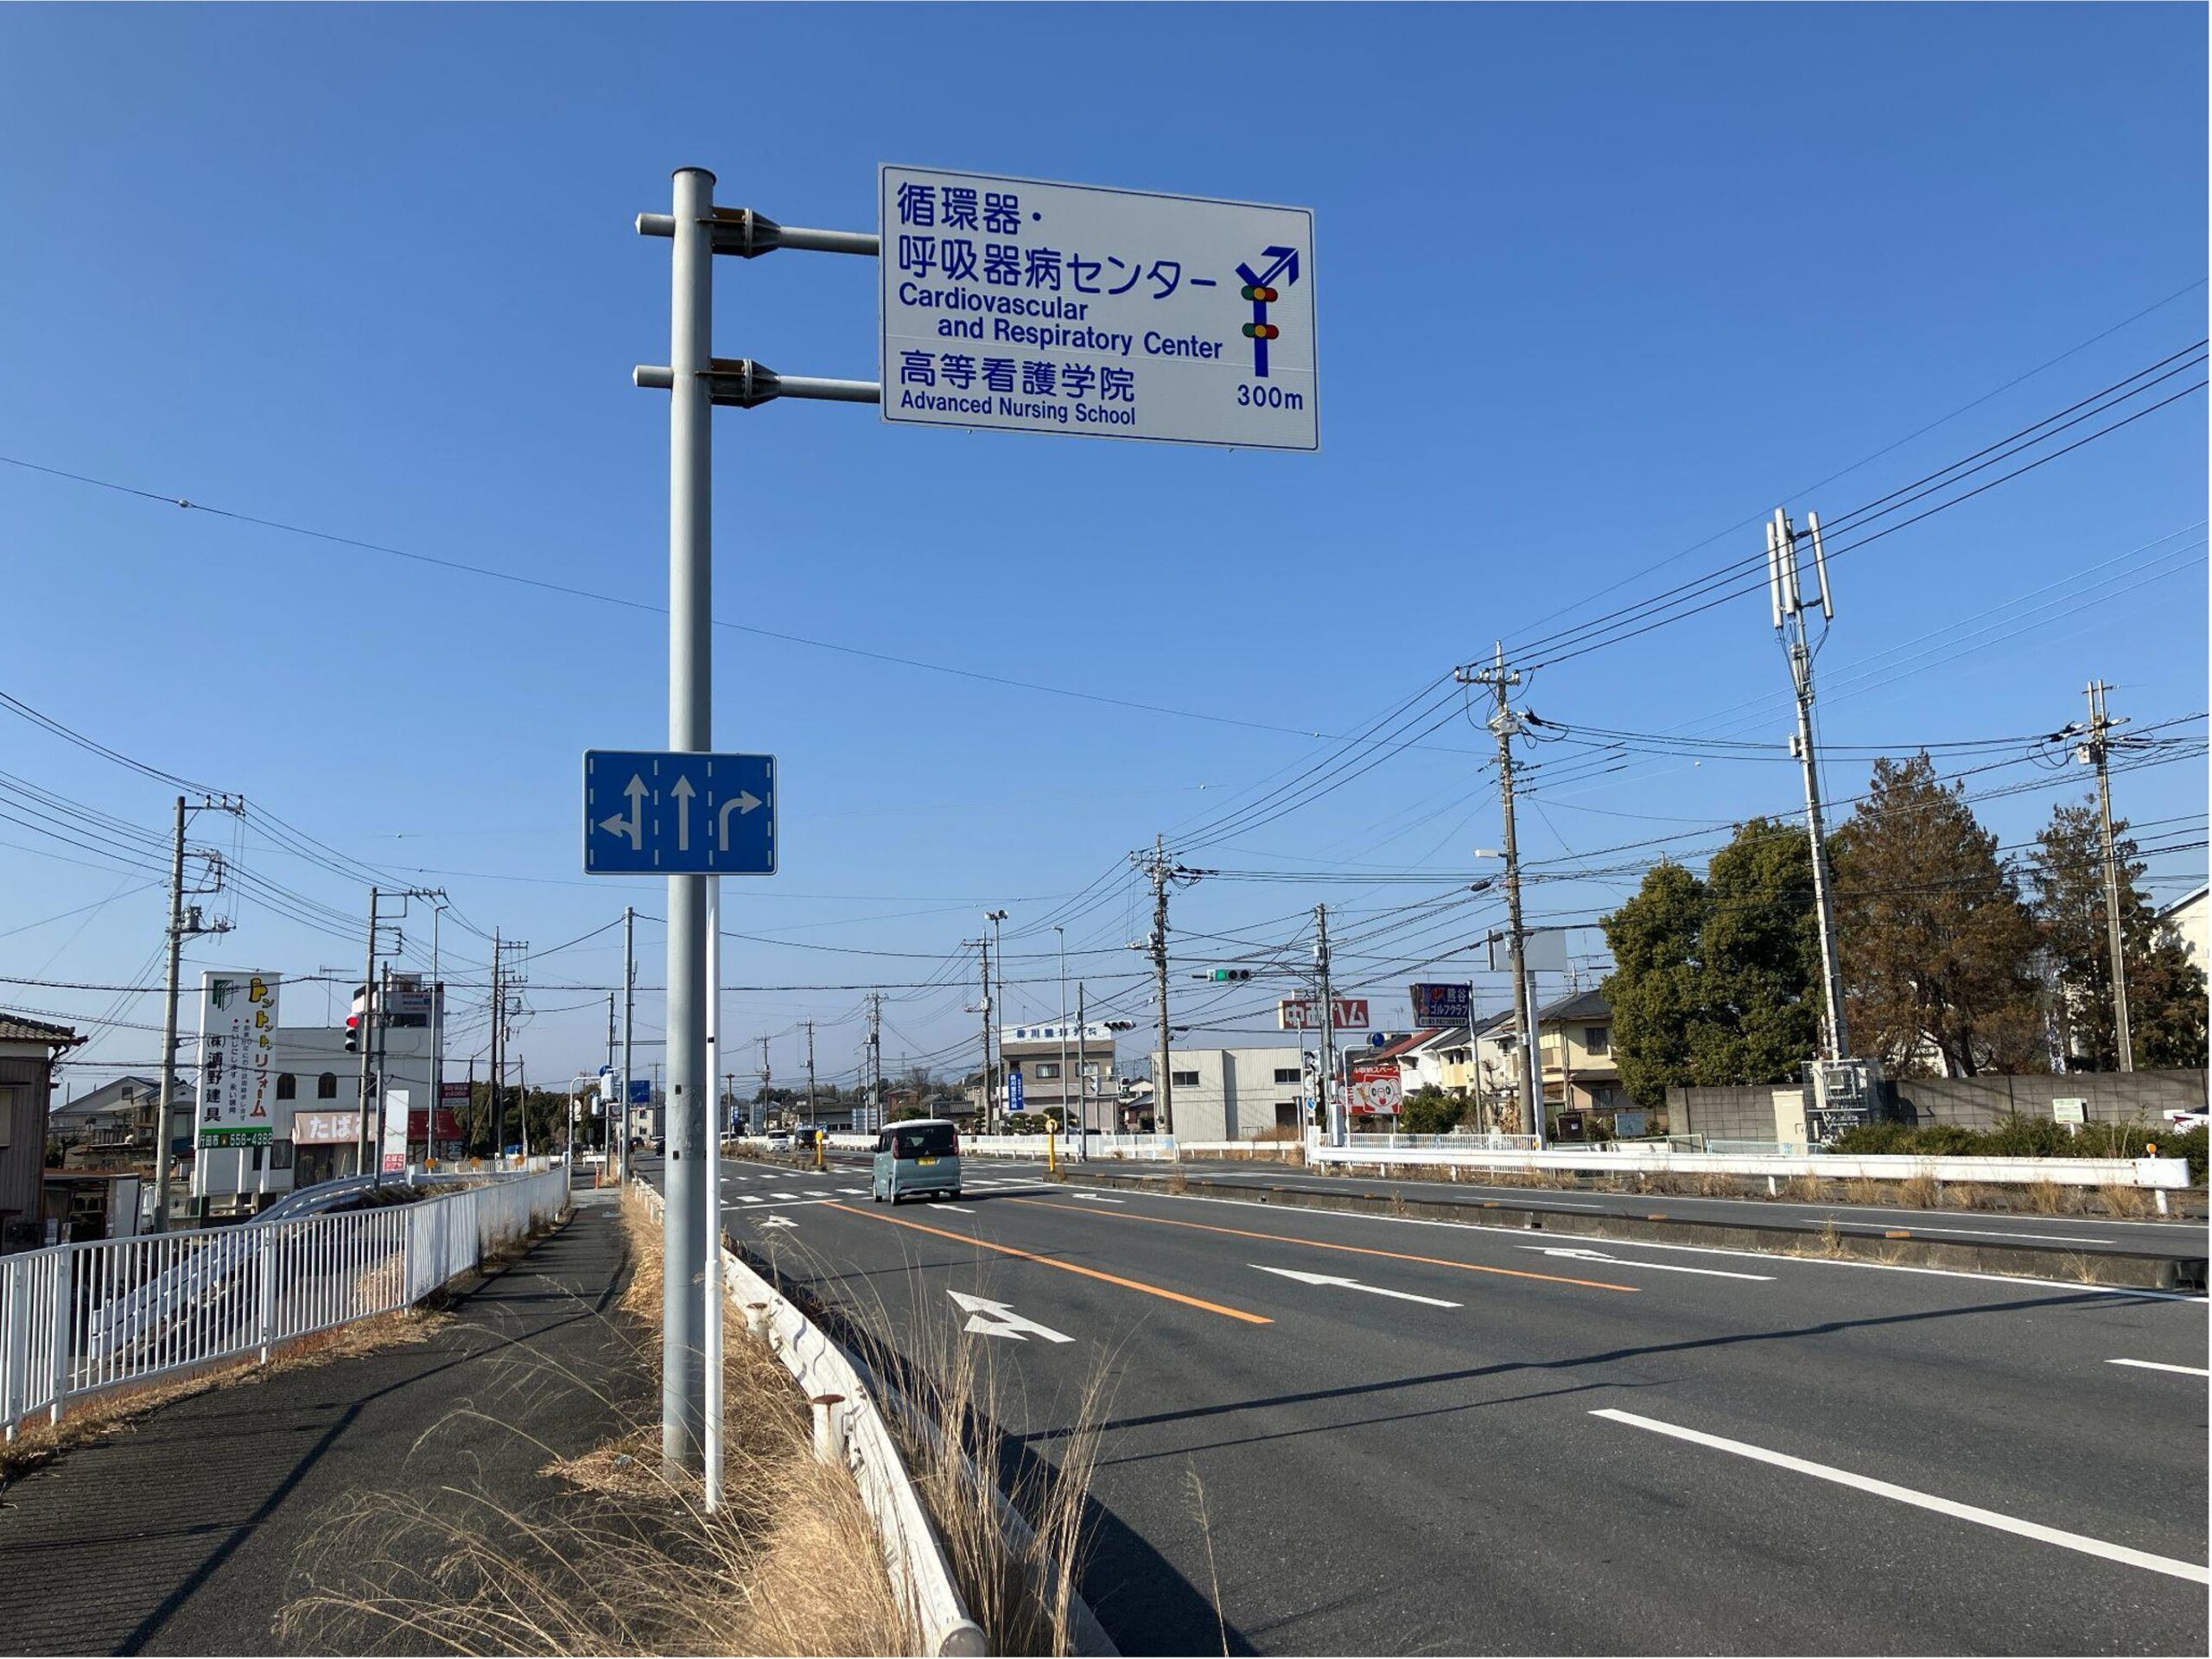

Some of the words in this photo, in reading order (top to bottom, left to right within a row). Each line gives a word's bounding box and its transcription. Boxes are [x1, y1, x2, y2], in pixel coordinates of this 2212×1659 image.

[897, 181, 1042, 236] 循環器・
[899, 234, 1217, 300] 呼吸器病センター
[899, 282, 1089, 321] Cardiovascular
[938, 316, 984, 339] and
[994, 317, 1133, 357] Respiratory
[1143, 330, 1224, 359] Center
[899, 349, 1135, 403] 高等看護学院
[900, 389, 993, 415] Advanced
[1000, 397, 1068, 423] Nursing
[1075, 403, 1136, 426] School
[1237, 384, 1303, 410] 300m
[1430, 1003, 1468, 1015] ゴルフクラブ
[1446, 987, 1466, 1003] 熊谷
[199, 1135, 219, 1147] 行田市
